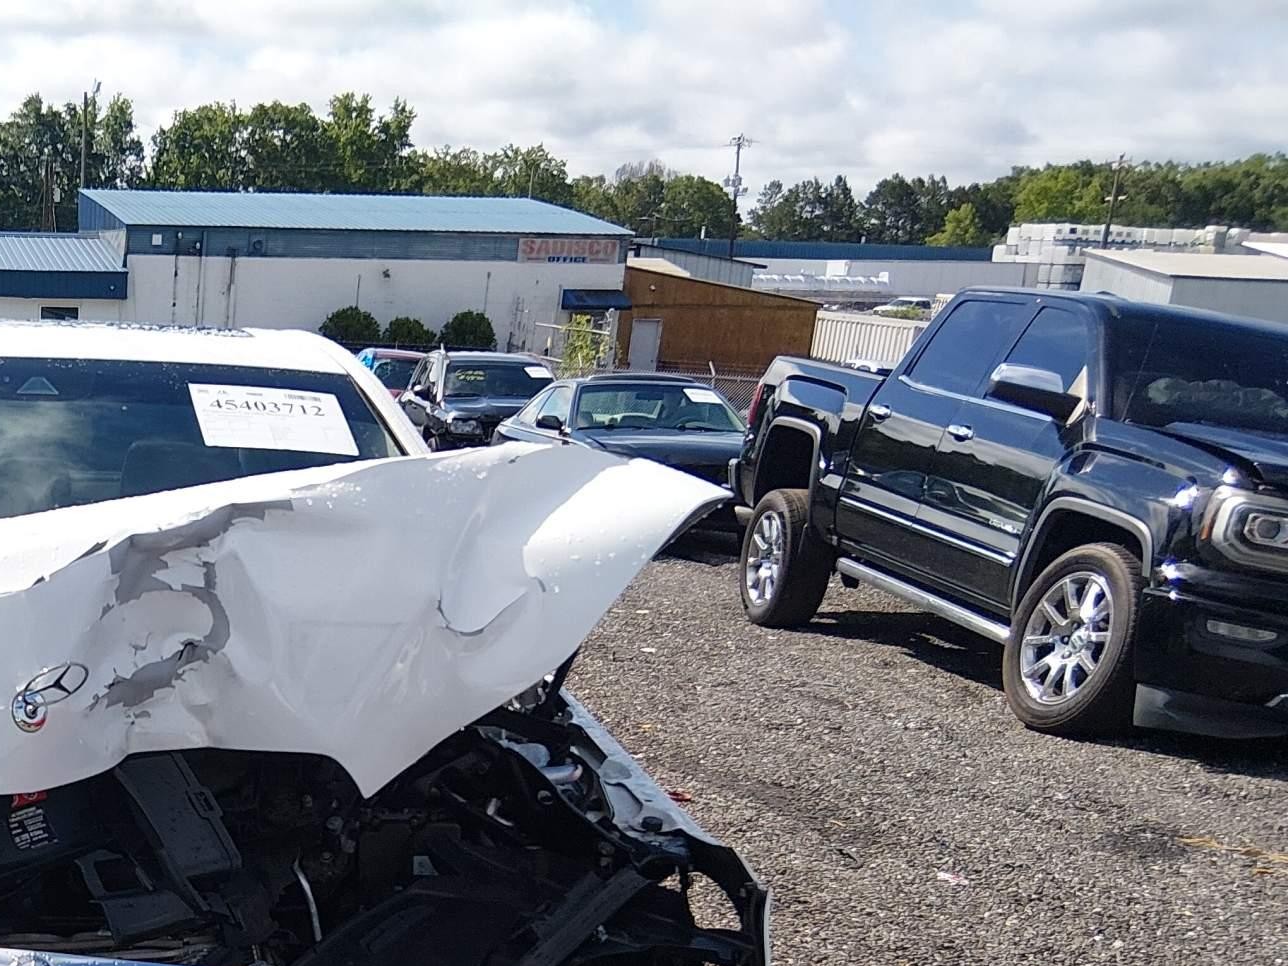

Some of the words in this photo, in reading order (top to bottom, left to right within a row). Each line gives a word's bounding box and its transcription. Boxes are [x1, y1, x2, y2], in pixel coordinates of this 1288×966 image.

[523, 239, 617, 256] SADISCO
[547, 256, 588, 264] OFFICE
[210, 399, 325, 416] 45403712
